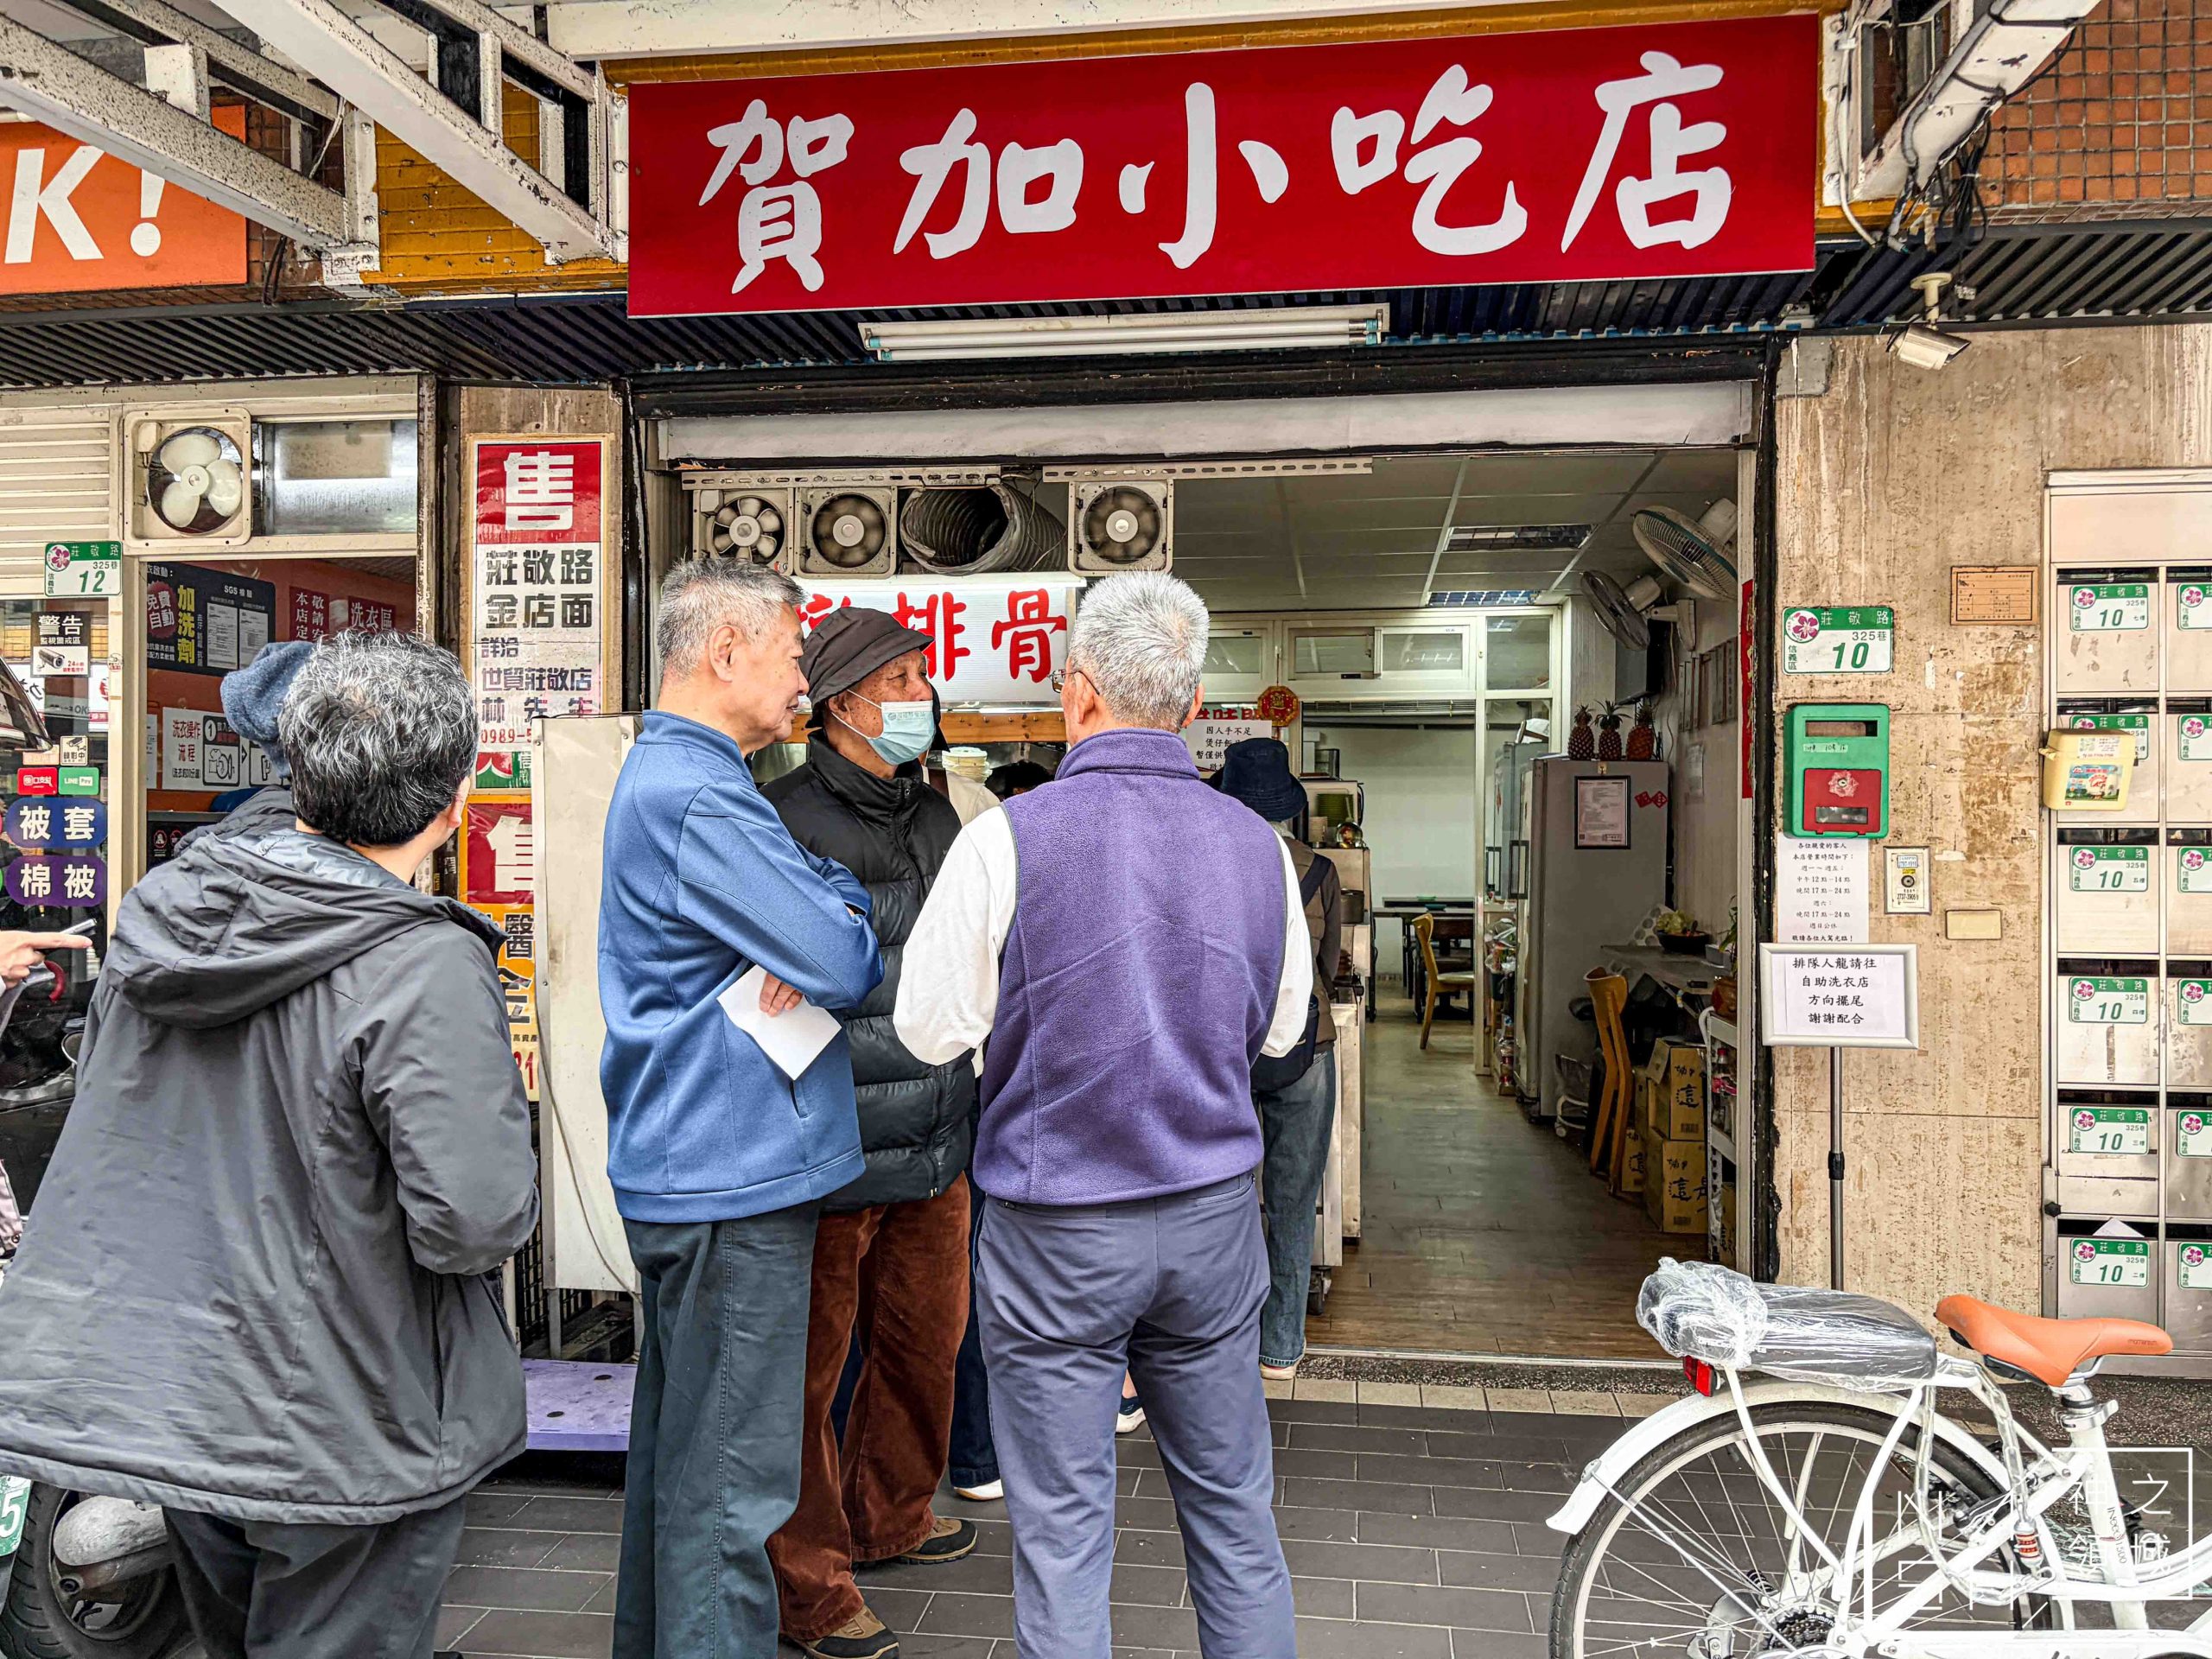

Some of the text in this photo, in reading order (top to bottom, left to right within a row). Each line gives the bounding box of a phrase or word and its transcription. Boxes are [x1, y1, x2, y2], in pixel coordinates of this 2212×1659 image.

[699, 50, 1732, 295] 賀加小吃店
[504, 451, 575, 531] 售
[71, 544, 119, 557] 莊敬路
[92, 561, 118, 570] 325巷
[486, 549, 594, 586] 莊敬路
[79, 569, 106, 594] 12
[147, 590, 171, 611] 免費
[485, 593, 594, 629] 金店面
[38, 615, 84, 636] 警告
[149, 608, 175, 630] 自動
[177, 584, 195, 664] 加洗劑
[296, 592, 308, 640] 本店定
[351, 601, 393, 633] 洗衣區
[1821, 610, 1890, 626] 莊敬路
[2099, 608, 2123, 627] 10
[1852, 631, 1888, 641] 325巷
[480, 637, 518, 658] 詳洽
[1788, 645, 1797, 671] 信義區
[1833, 641, 1870, 670] 10
[481, 666, 593, 692] 世貿莊敬店
[1206, 726, 1252, 736] 因人手不足
[20, 805, 95, 841] 被套
[20, 862, 95, 899] 棉被
[2099, 871, 2123, 888] 10
[1792, 957, 1878, 970] 排隊人龍請往
[1802, 976, 1870, 988] 自助洗衣店
[1808, 995, 1864, 1007] 方向擺尾
[2098, 1001, 2122, 1020] 10
[1808, 1012, 1865, 1025] 謝謝配合
[2099, 1133, 2123, 1150] 10
[2099, 1264, 2123, 1282] 10
